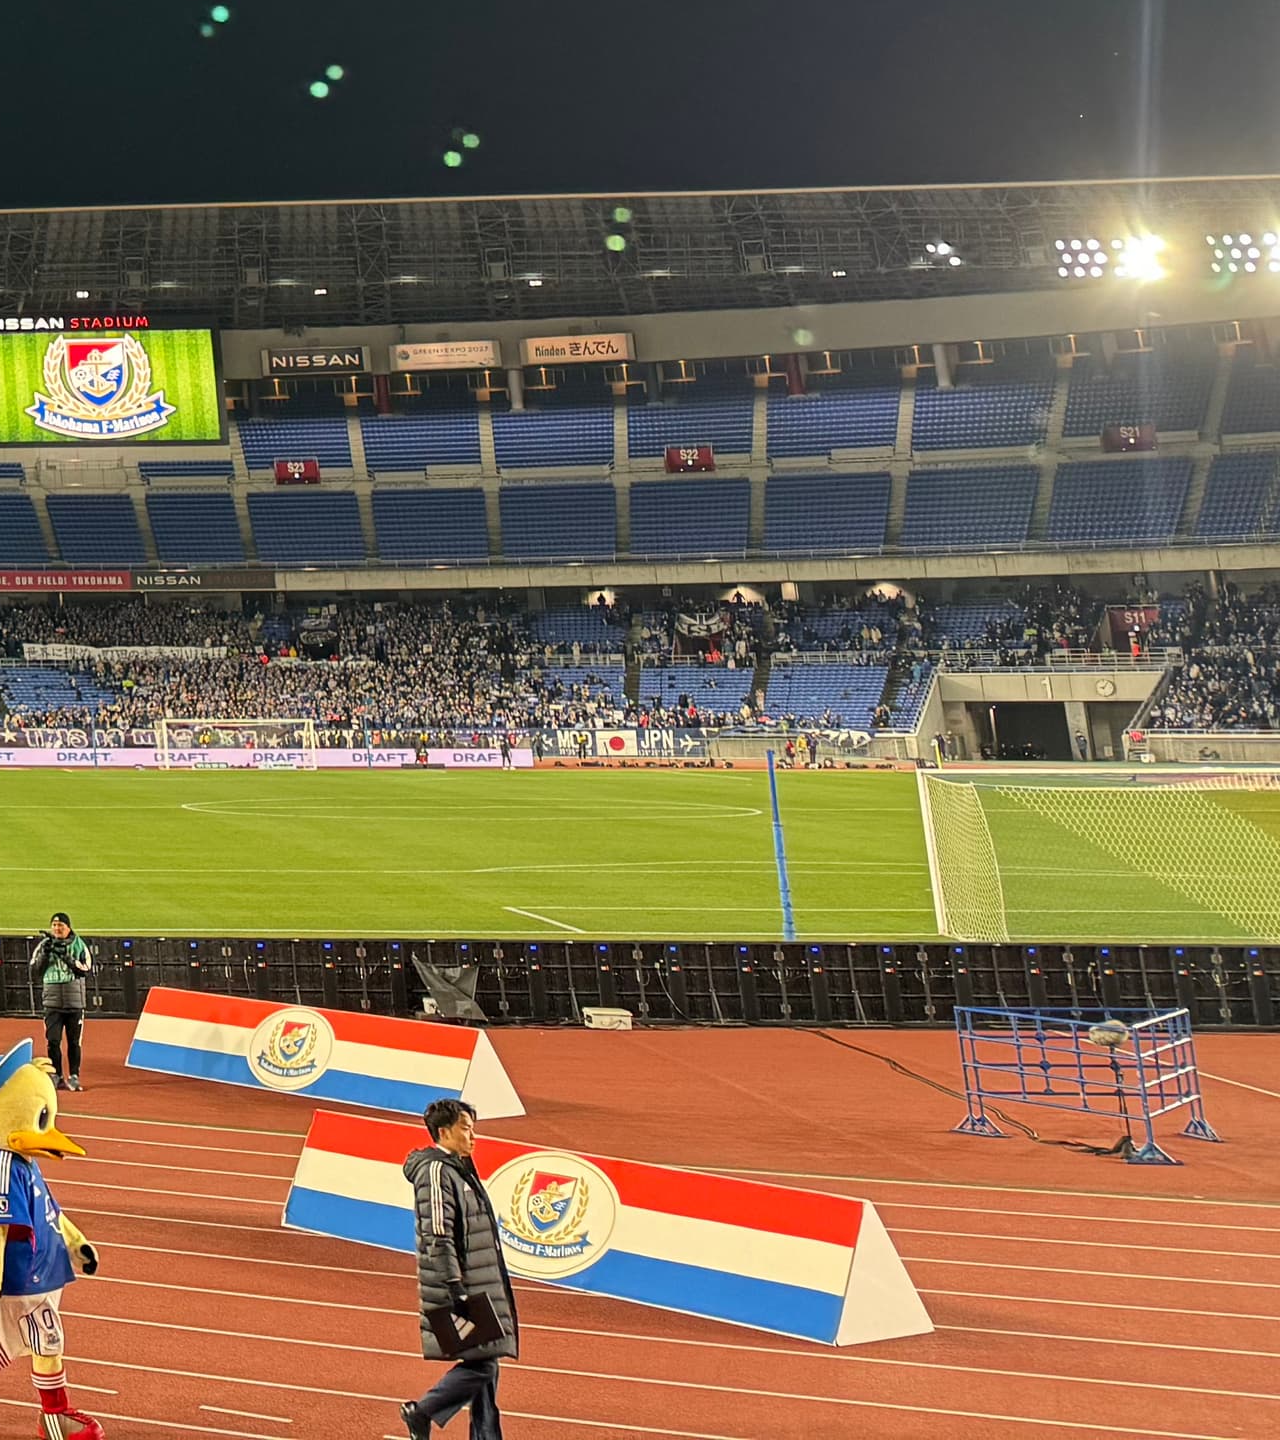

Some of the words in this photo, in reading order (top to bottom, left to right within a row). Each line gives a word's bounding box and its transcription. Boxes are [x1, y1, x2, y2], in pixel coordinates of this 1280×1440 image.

[70, 316, 149, 328] STADIUM
[535, 344, 566, 357] Kinden
[568, 340, 619, 357] きんでん
[271, 353, 360, 369] NISSAN
[43, 410, 101, 433] Yokohama
[1119, 426, 1141, 439] S21
[679, 448, 699, 460] S22
[287, 462, 305, 474] S23
[15, 575, 34, 586] OUR
[71, 575, 123, 586] YOKOHAMA
[136, 574, 201, 586] NISSAN
[1124, 612, 1146, 625] S11
[640, 728, 674, 749] JPN
